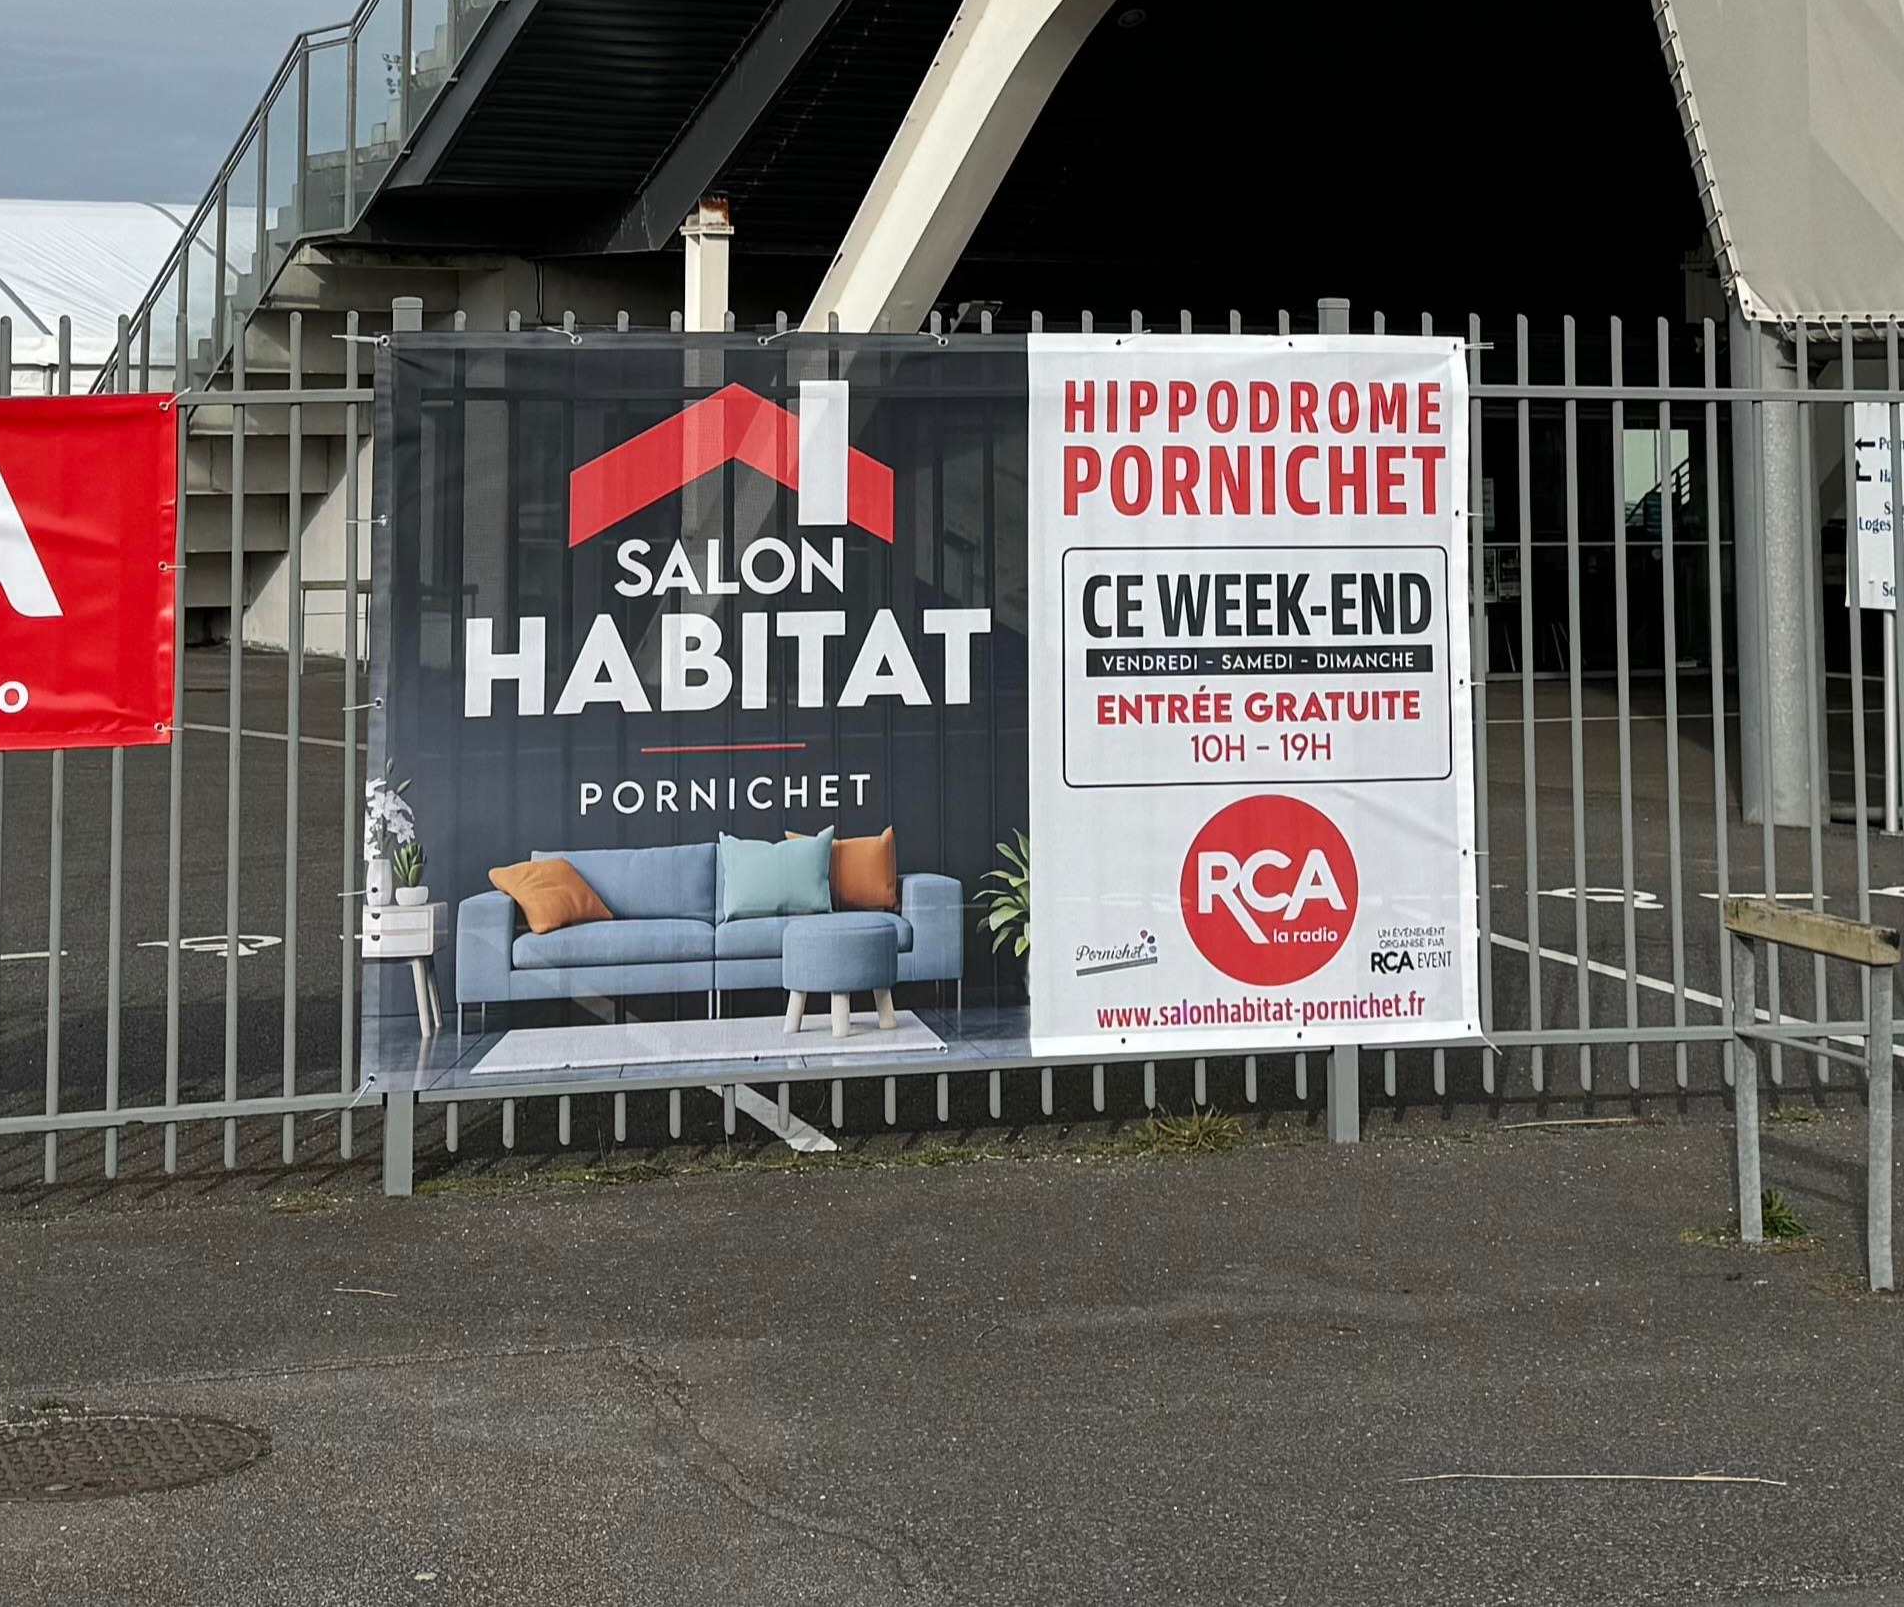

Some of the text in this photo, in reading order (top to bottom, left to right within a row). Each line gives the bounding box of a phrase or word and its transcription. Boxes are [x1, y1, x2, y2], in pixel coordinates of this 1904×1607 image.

[1063, 379, 1442, 434] HIPPODROME
[1063, 444, 1446, 516] PORNICHET
[1859, 516, 1891, 534] Loges
[614, 536, 844, 596] SALON
[1081, 572, 1432, 638] CE WEEK-END
[464, 607, 992, 718] HABITAT
[1102, 653, 1198, 672] VENDREDI
[1221, 653, 1293, 670] SAMEDI
[1316, 651, 1414, 669] DIMANCHE
[1096, 684, 1420, 725] ENTRÉE GRATUITE
[1191, 733, 1245, 763] 10H
[1280, 732, 1332, 762] 19H
[580, 774, 871, 815] PORNICHET
[1197, 848, 1348, 945] RCA
[1075, 943, 1145, 961] Pornichet
[1272, 926, 1338, 944] la radio
[1371, 950, 1452, 974] RCA EVENT
[1097, 990, 1426, 1029] www.salonhabitat-pornichet.fr
